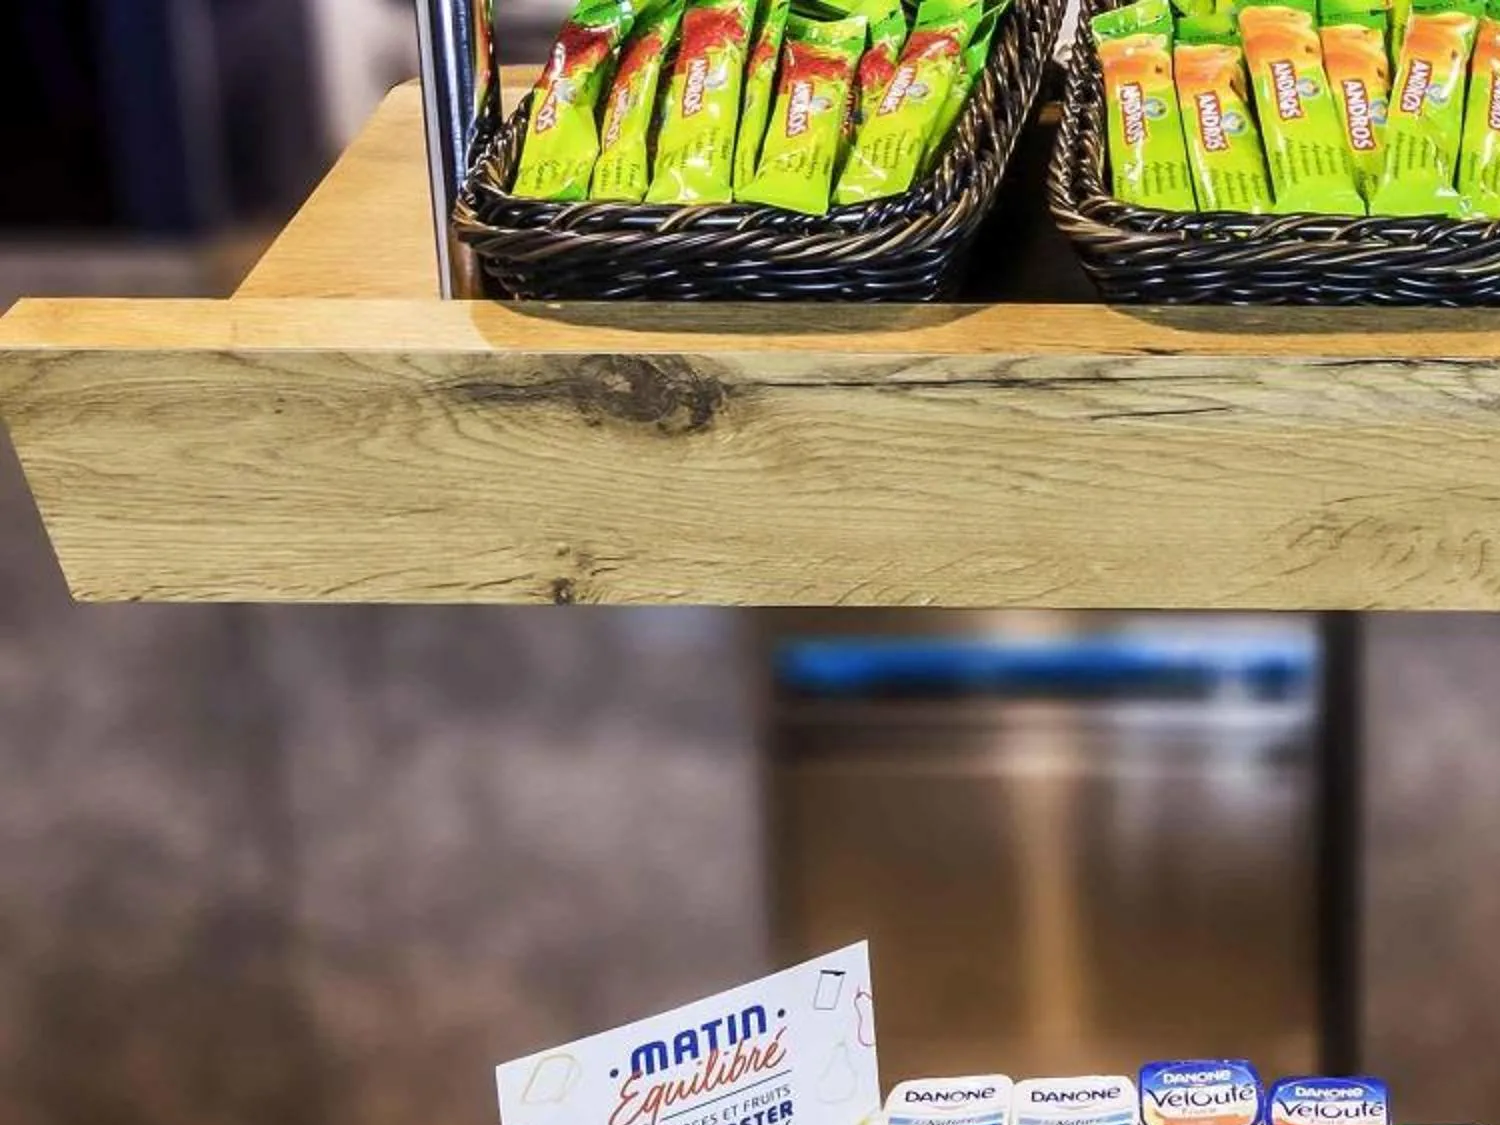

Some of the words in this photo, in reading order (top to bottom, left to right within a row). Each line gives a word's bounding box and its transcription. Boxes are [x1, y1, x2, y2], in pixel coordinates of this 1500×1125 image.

[1344, 81, 1373, 148] ANDROS
[631, 1004, 768, 1077] MATIN
[1163, 1070, 1232, 1084] DANONE
[905, 1087, 996, 1103] DANONE
[1031, 1087, 1121, 1103] DANONE
[1295, 1086, 1364, 1098] DANONE
[723, 1102, 739, 1121] ET
[743, 1084, 791, 1113] FRUITS
